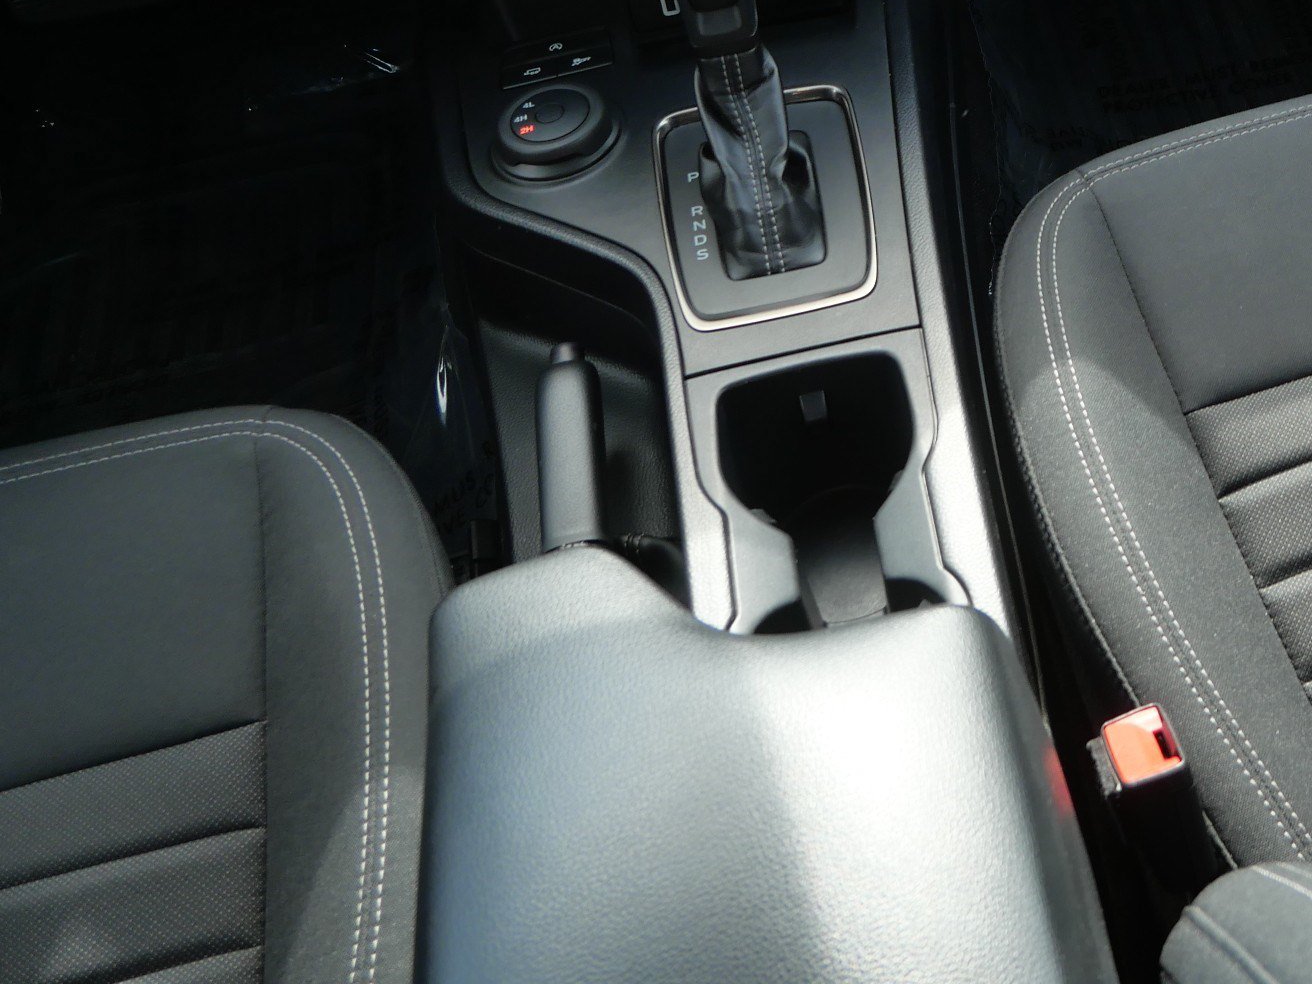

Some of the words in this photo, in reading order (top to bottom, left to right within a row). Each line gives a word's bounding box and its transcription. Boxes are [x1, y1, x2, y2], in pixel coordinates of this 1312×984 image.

[522, 101, 536, 109] 4L
[513, 114, 528, 123] 4H
[519, 124, 535, 135] 2H
[687, 171, 700, 183] P
[691, 205, 704, 217] R
[692, 219, 707, 232] N
[694, 234, 707, 247] D
[696, 248, 709, 261] S
